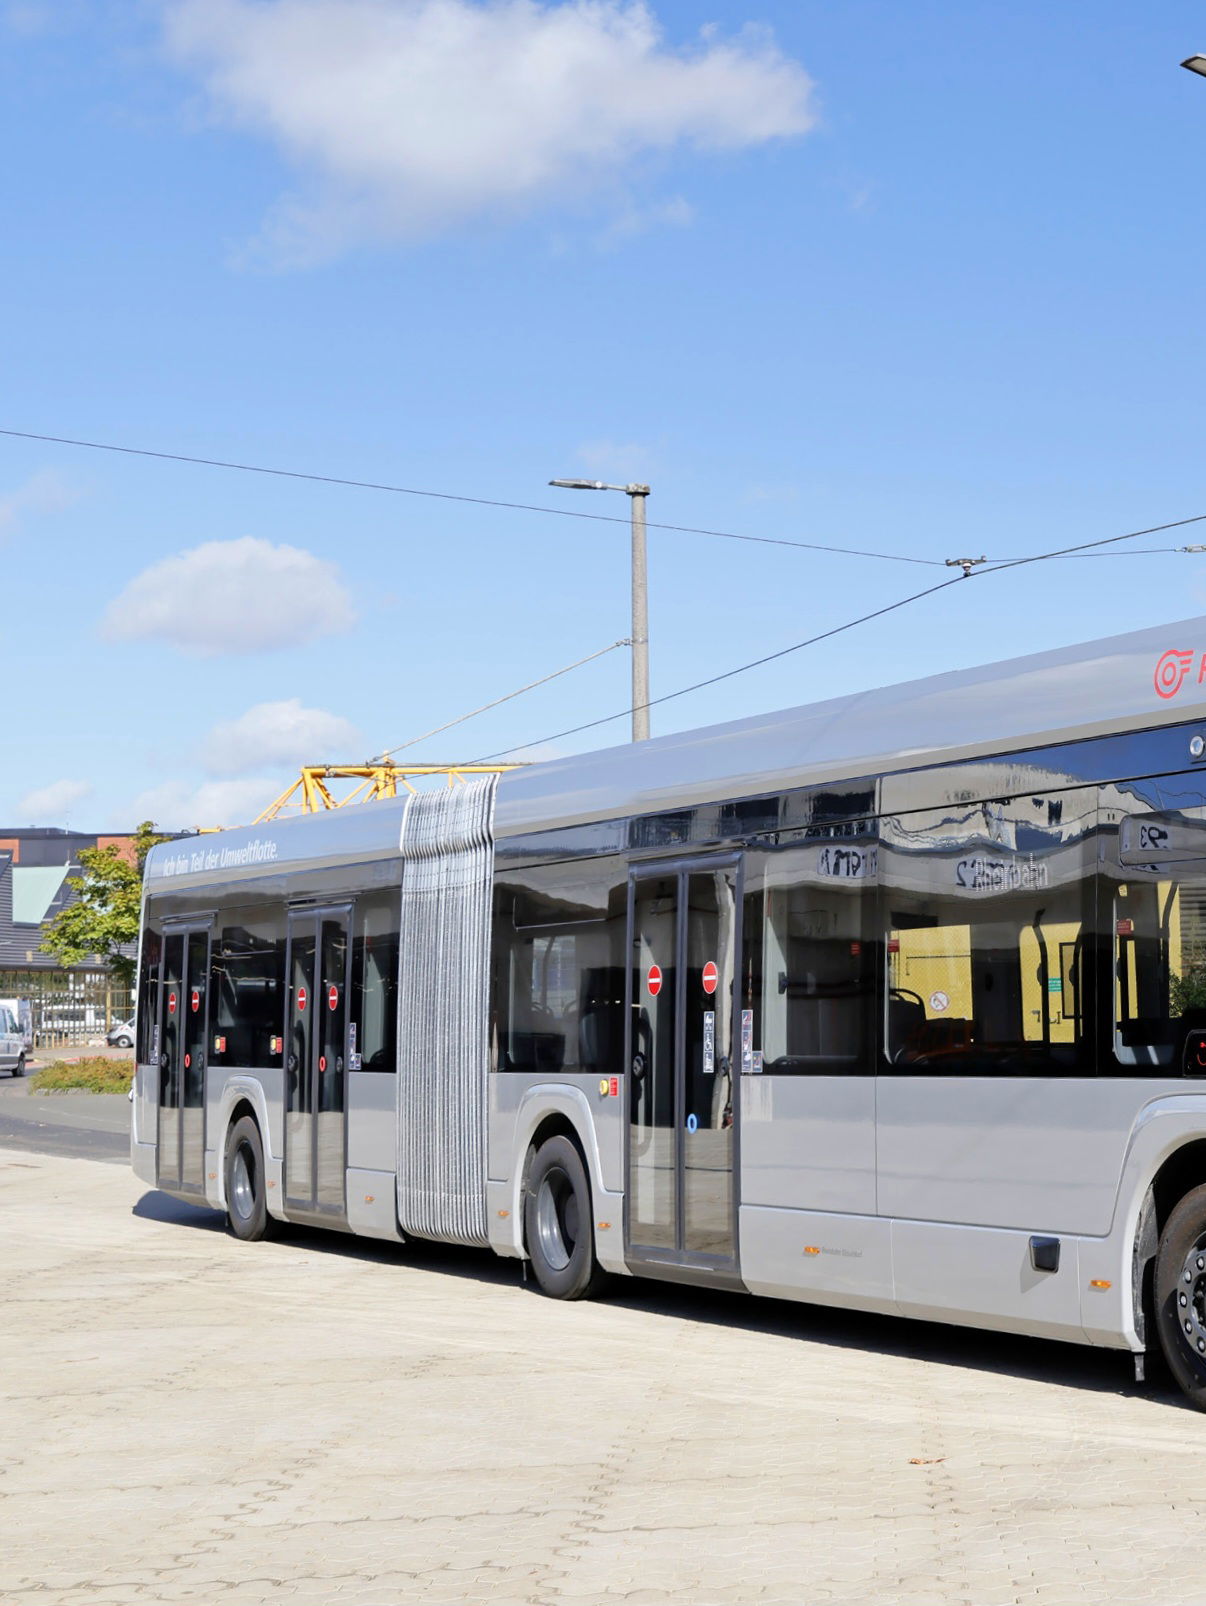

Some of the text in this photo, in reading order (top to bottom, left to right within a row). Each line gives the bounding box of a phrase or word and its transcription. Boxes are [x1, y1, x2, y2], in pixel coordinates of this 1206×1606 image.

[162, 839, 279, 877] Ich bin Teil der Umweltflotte.
